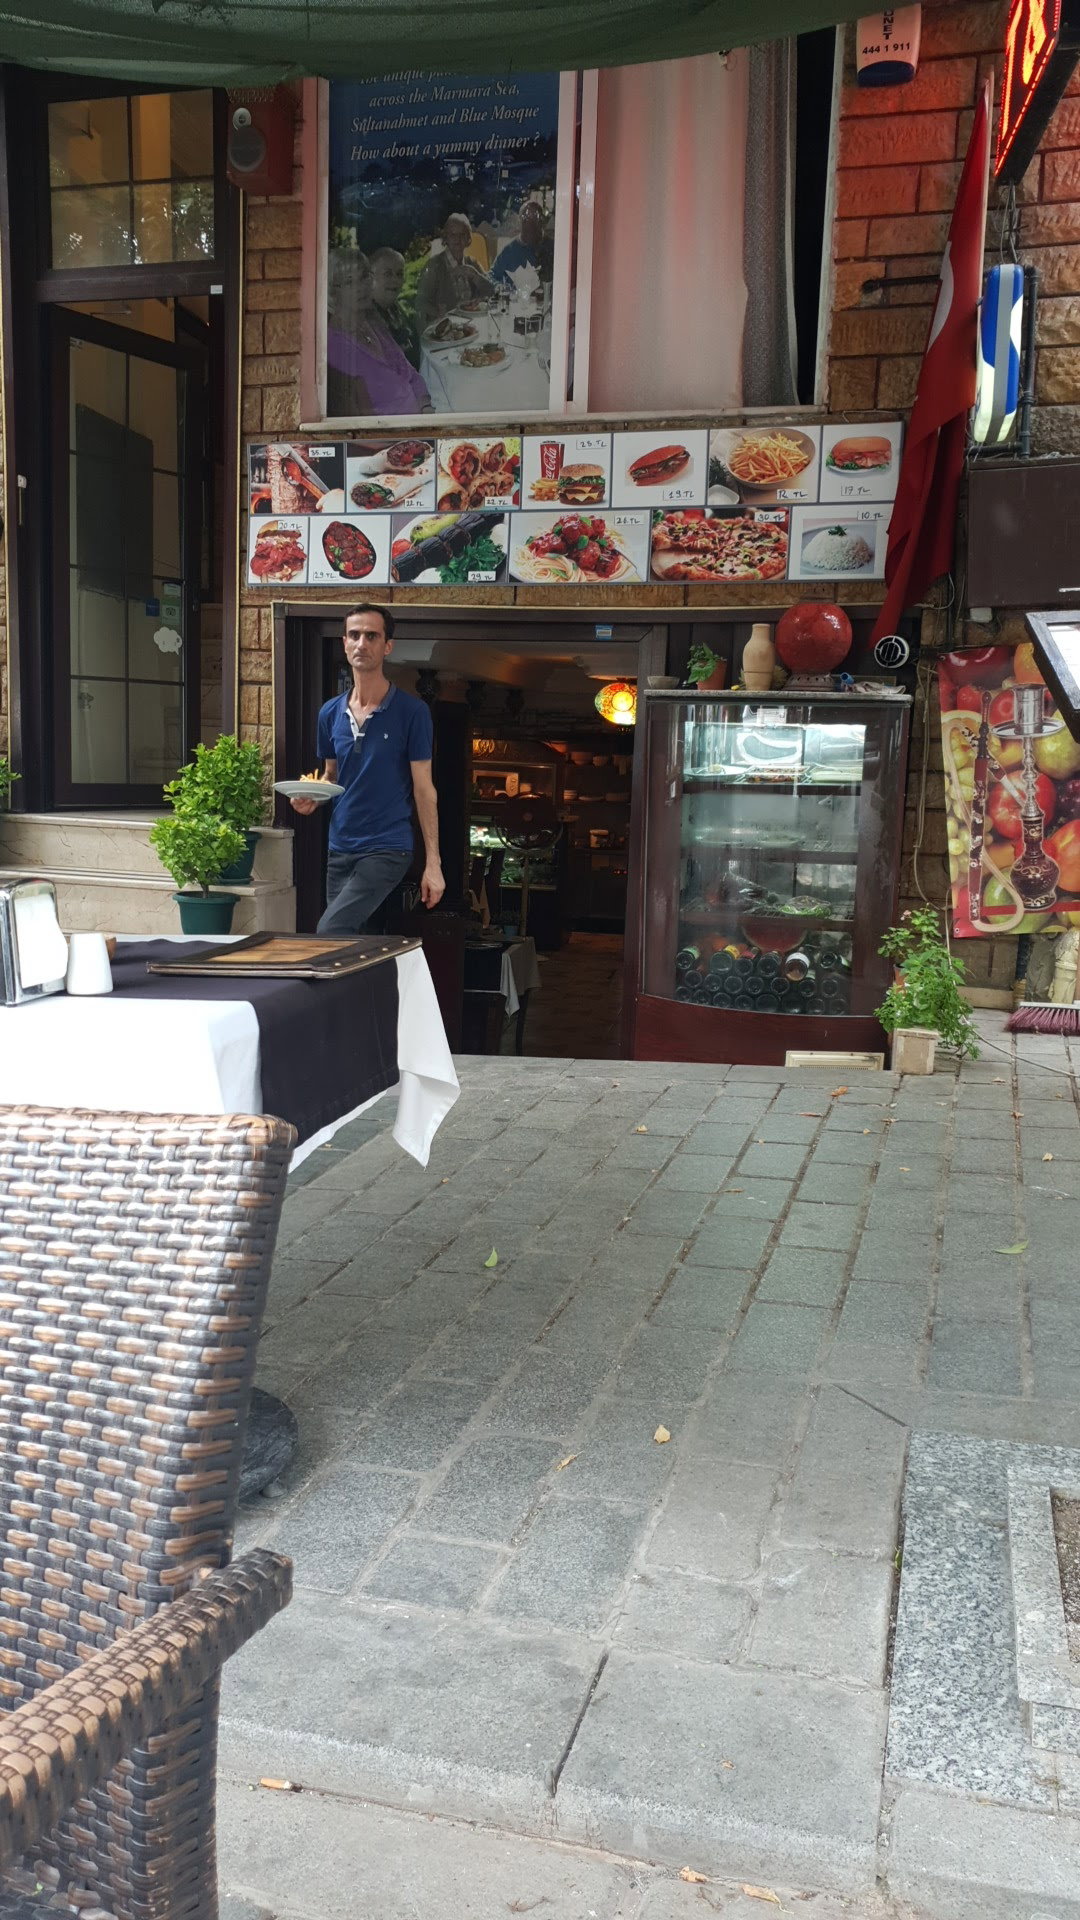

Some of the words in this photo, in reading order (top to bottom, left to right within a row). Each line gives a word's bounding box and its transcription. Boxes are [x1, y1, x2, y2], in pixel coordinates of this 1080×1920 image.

[862, 46, 880, 54] 444
[893, 42, 911, 51] 911
[368, 94, 405, 108] across
[409, 88, 428, 103] the
[430, 85, 491, 101] Marmara
[494, 80, 520, 96] Sea,
[351, 113, 428, 134] Sultanahmet
[431, 108, 456, 125] and
[459, 106, 488, 123] Blue
[490, 104, 540, 123] Mosque
[350, 145, 381, 161] How
[382, 141, 420, 159] about
[422, 147, 431, 157] a
[432, 140, 482, 160] yummy
[484, 132, 530, 151] dinner
[532, 131, 541, 147] ?
